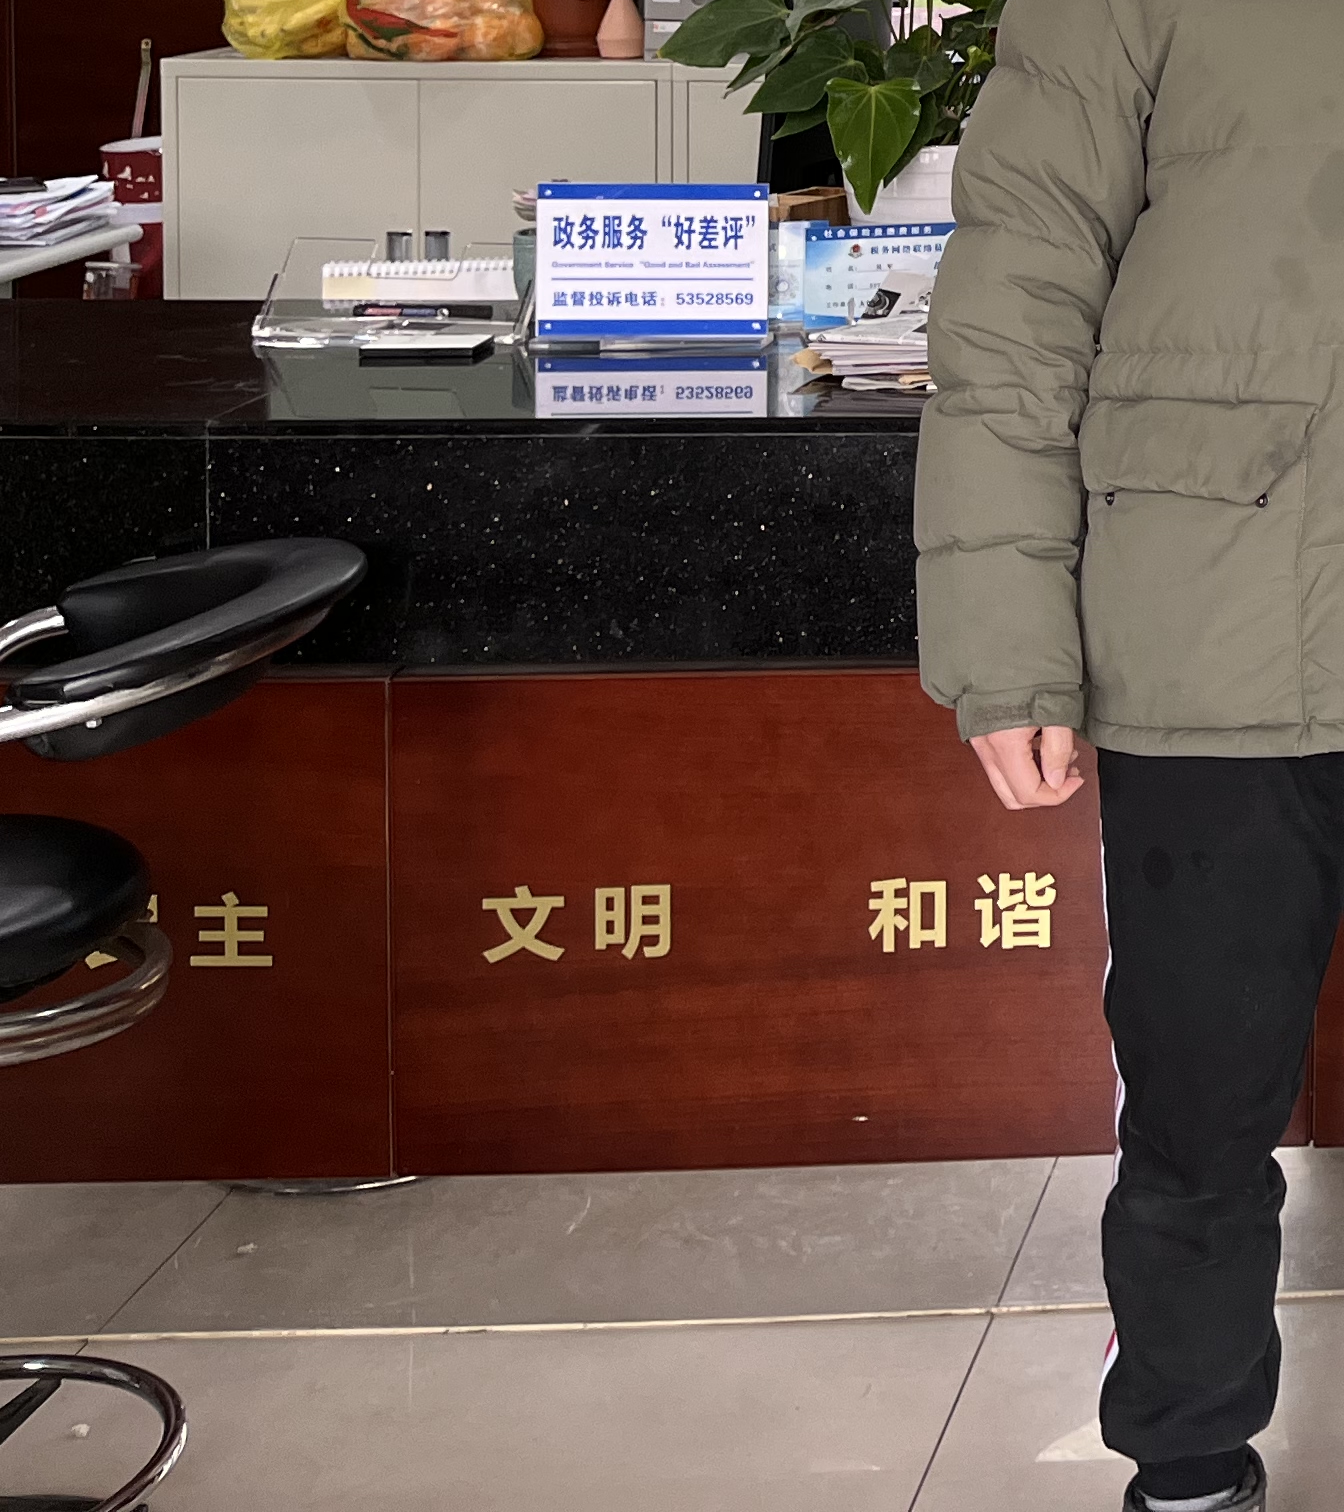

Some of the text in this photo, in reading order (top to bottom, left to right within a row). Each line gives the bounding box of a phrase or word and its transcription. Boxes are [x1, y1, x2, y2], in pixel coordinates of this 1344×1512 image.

[85, 890, 274, 970] 主
[481, 883, 673, 962] 文明
[867, 872, 1059, 954] 和谐
